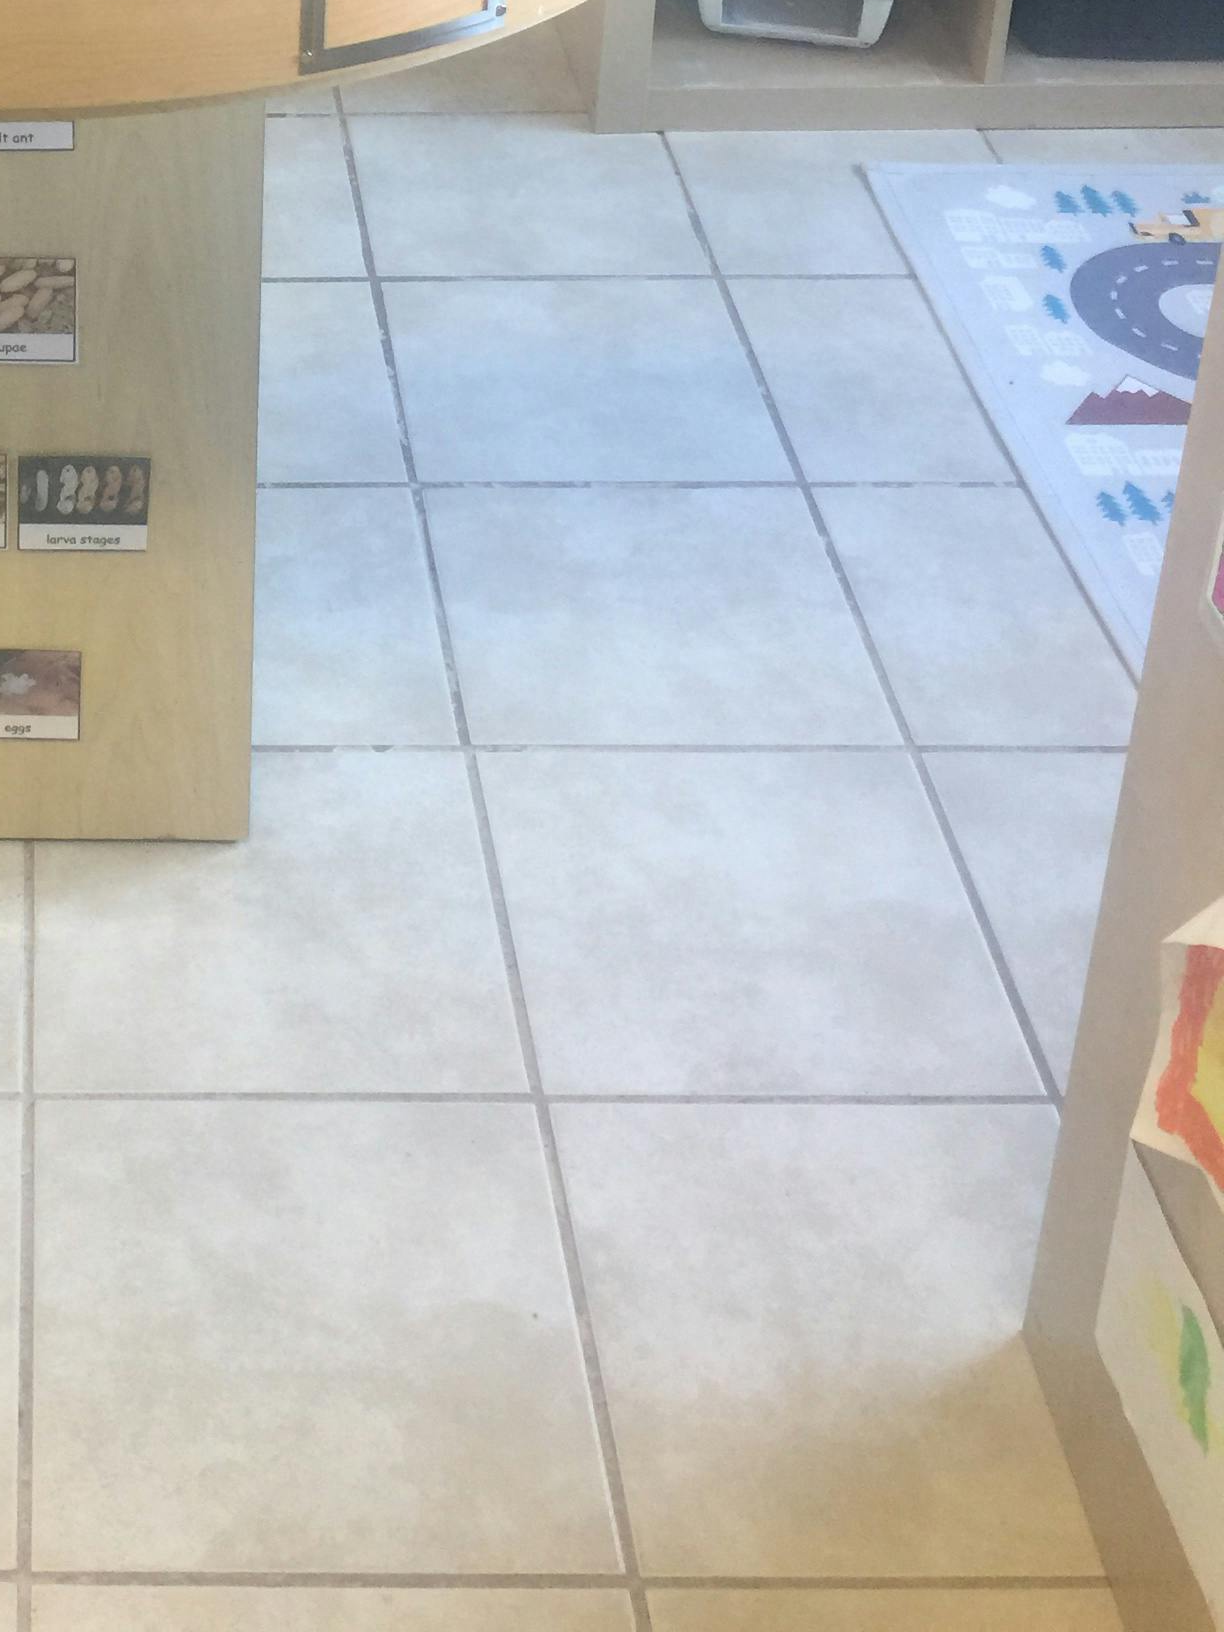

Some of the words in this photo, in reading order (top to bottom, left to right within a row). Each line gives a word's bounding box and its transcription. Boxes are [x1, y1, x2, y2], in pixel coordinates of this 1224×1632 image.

[12, 133, 35, 144] ant
[46, 534, 77, 545] larva
[80, 534, 121, 548] stages
[4, 724, 32, 735] eggs
